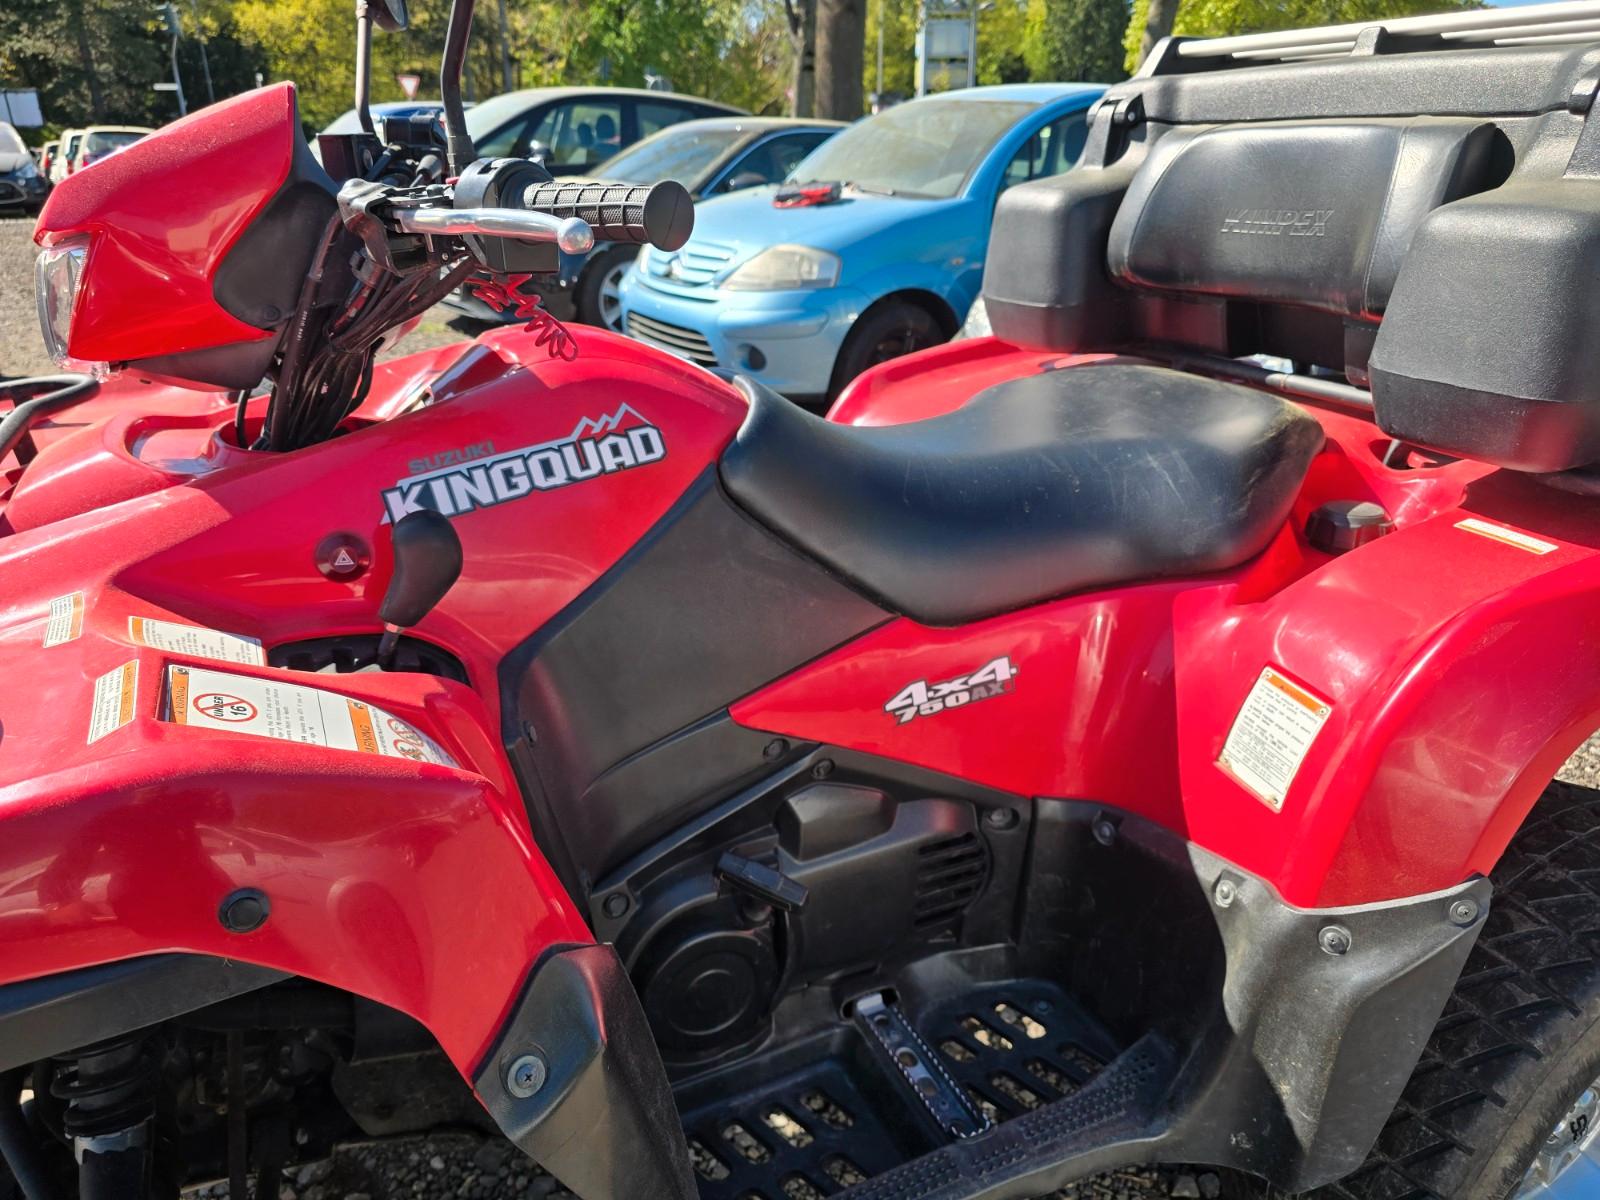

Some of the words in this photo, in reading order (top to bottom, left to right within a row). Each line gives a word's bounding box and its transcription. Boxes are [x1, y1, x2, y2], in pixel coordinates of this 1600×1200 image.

[1220, 208, 1335, 236] KIMPEX
[408, 438, 496, 474] SUZUKI
[383, 426, 665, 524] KINGQUAD
[213, 696, 224, 717] UNDER
[230, 705, 247, 715] 16
